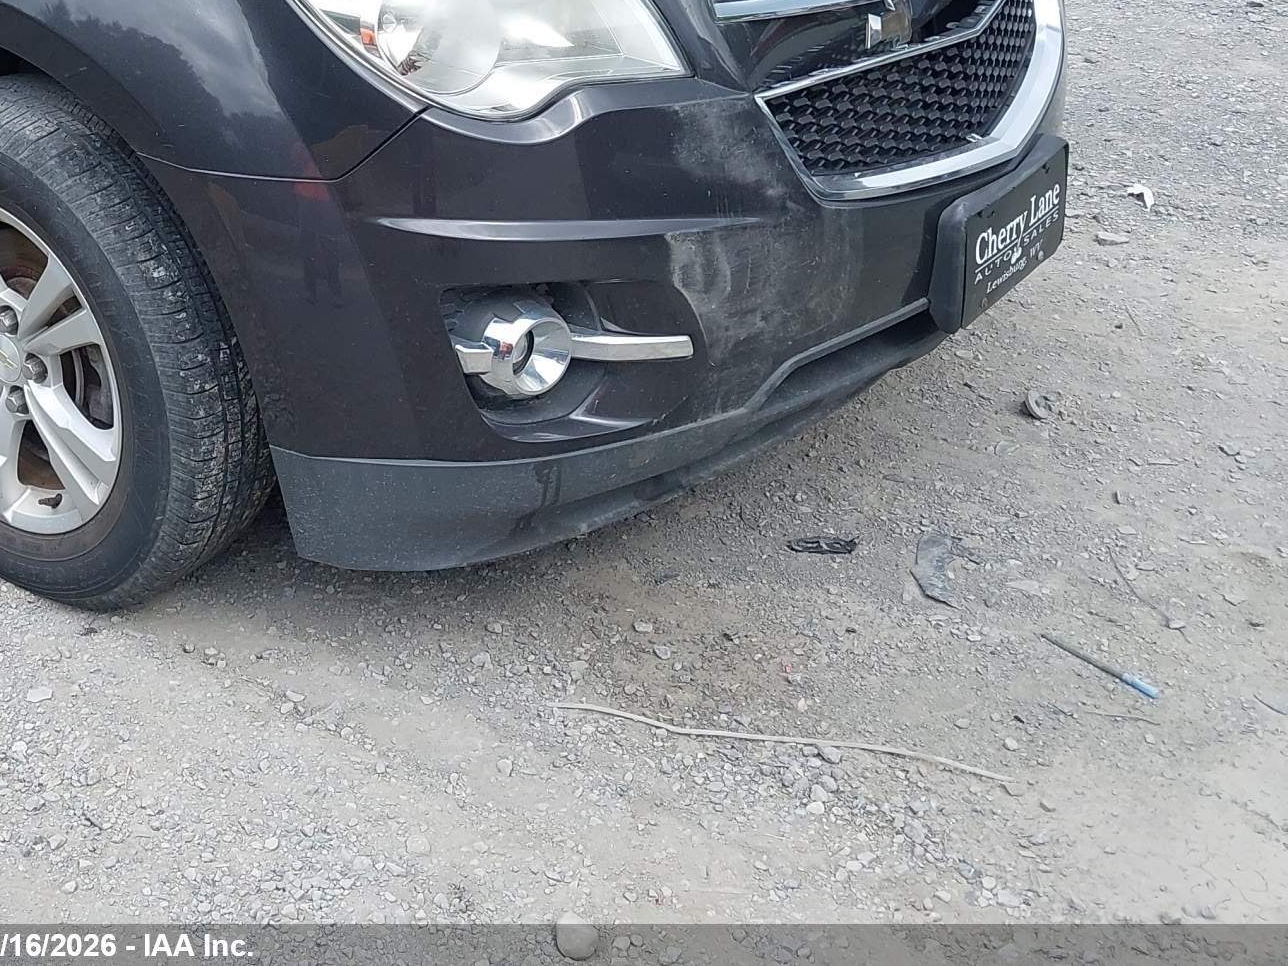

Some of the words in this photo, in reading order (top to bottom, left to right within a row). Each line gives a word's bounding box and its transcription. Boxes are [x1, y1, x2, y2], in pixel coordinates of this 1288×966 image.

[974, 249, 1012, 284] AUTO
[1023, 210, 1059, 246] SALES
[975, 209, 1027, 265] Cherry
[1029, 183, 1061, 226] Lane
